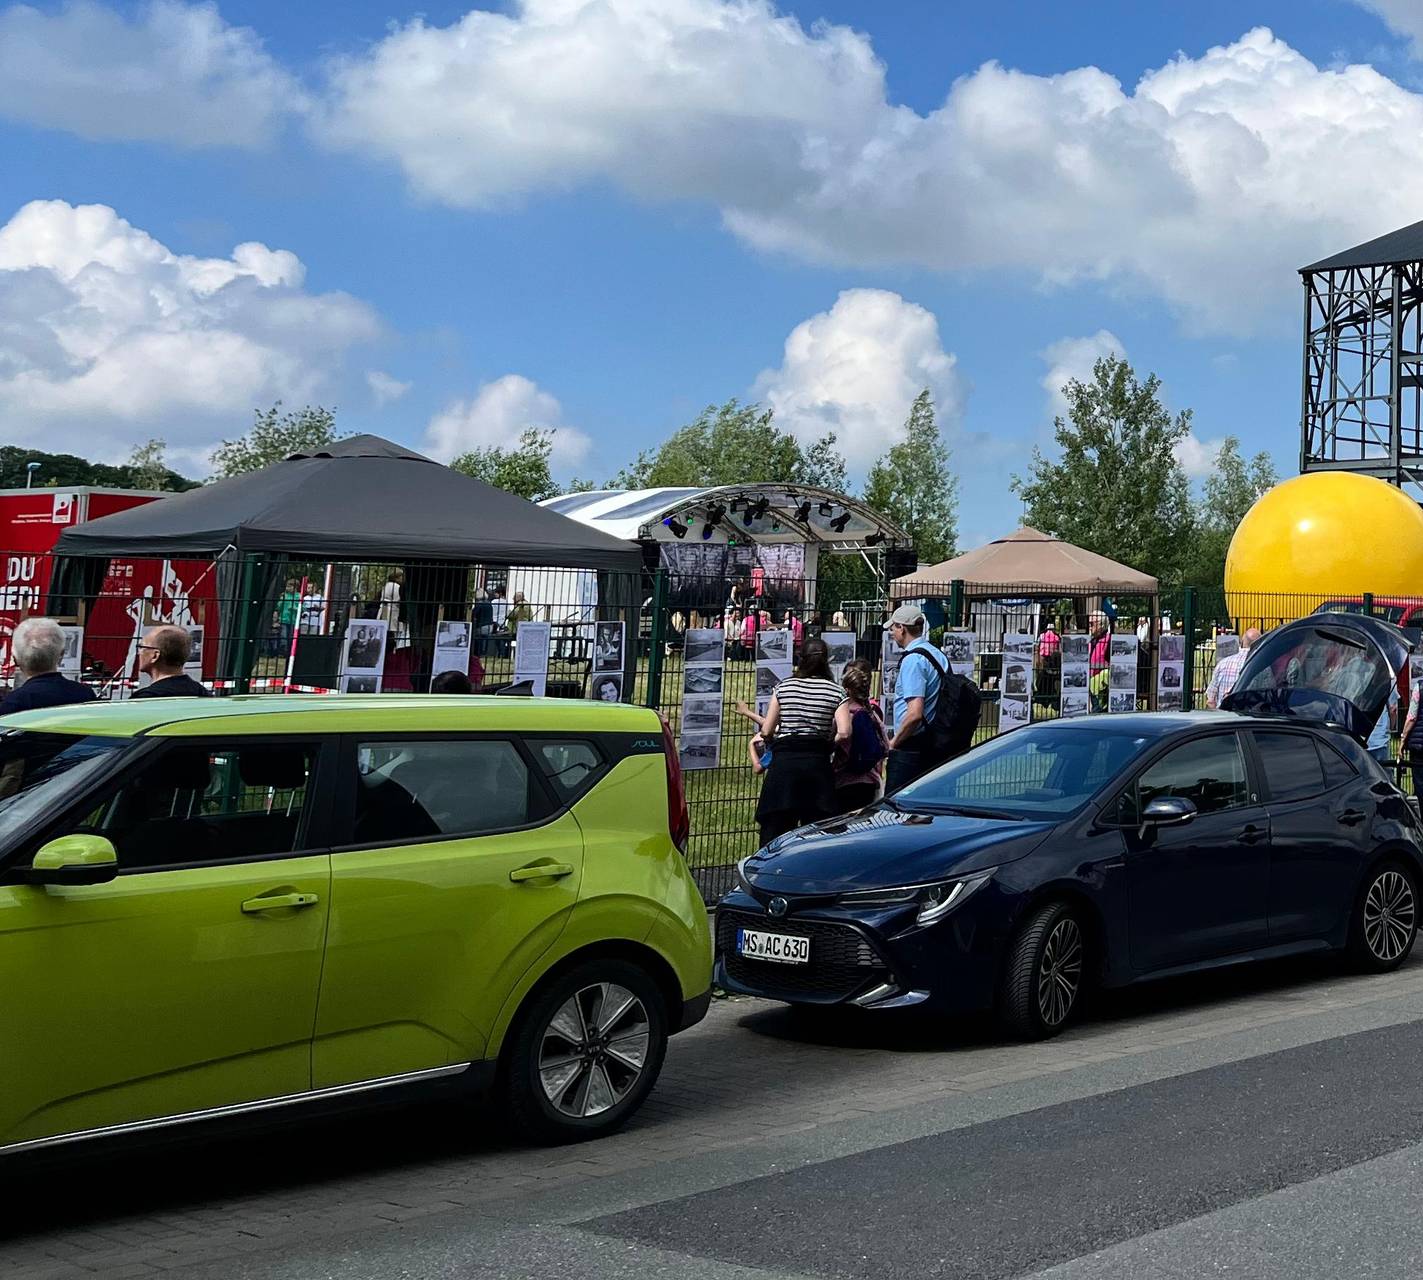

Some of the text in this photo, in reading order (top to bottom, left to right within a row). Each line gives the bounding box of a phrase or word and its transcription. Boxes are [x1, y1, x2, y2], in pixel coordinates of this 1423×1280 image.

[7, 557, 35, 581] DU
[743, 933, 758, 953] MS
[765, 936, 781, 956] AC
[783, 938, 808, 959] 630
